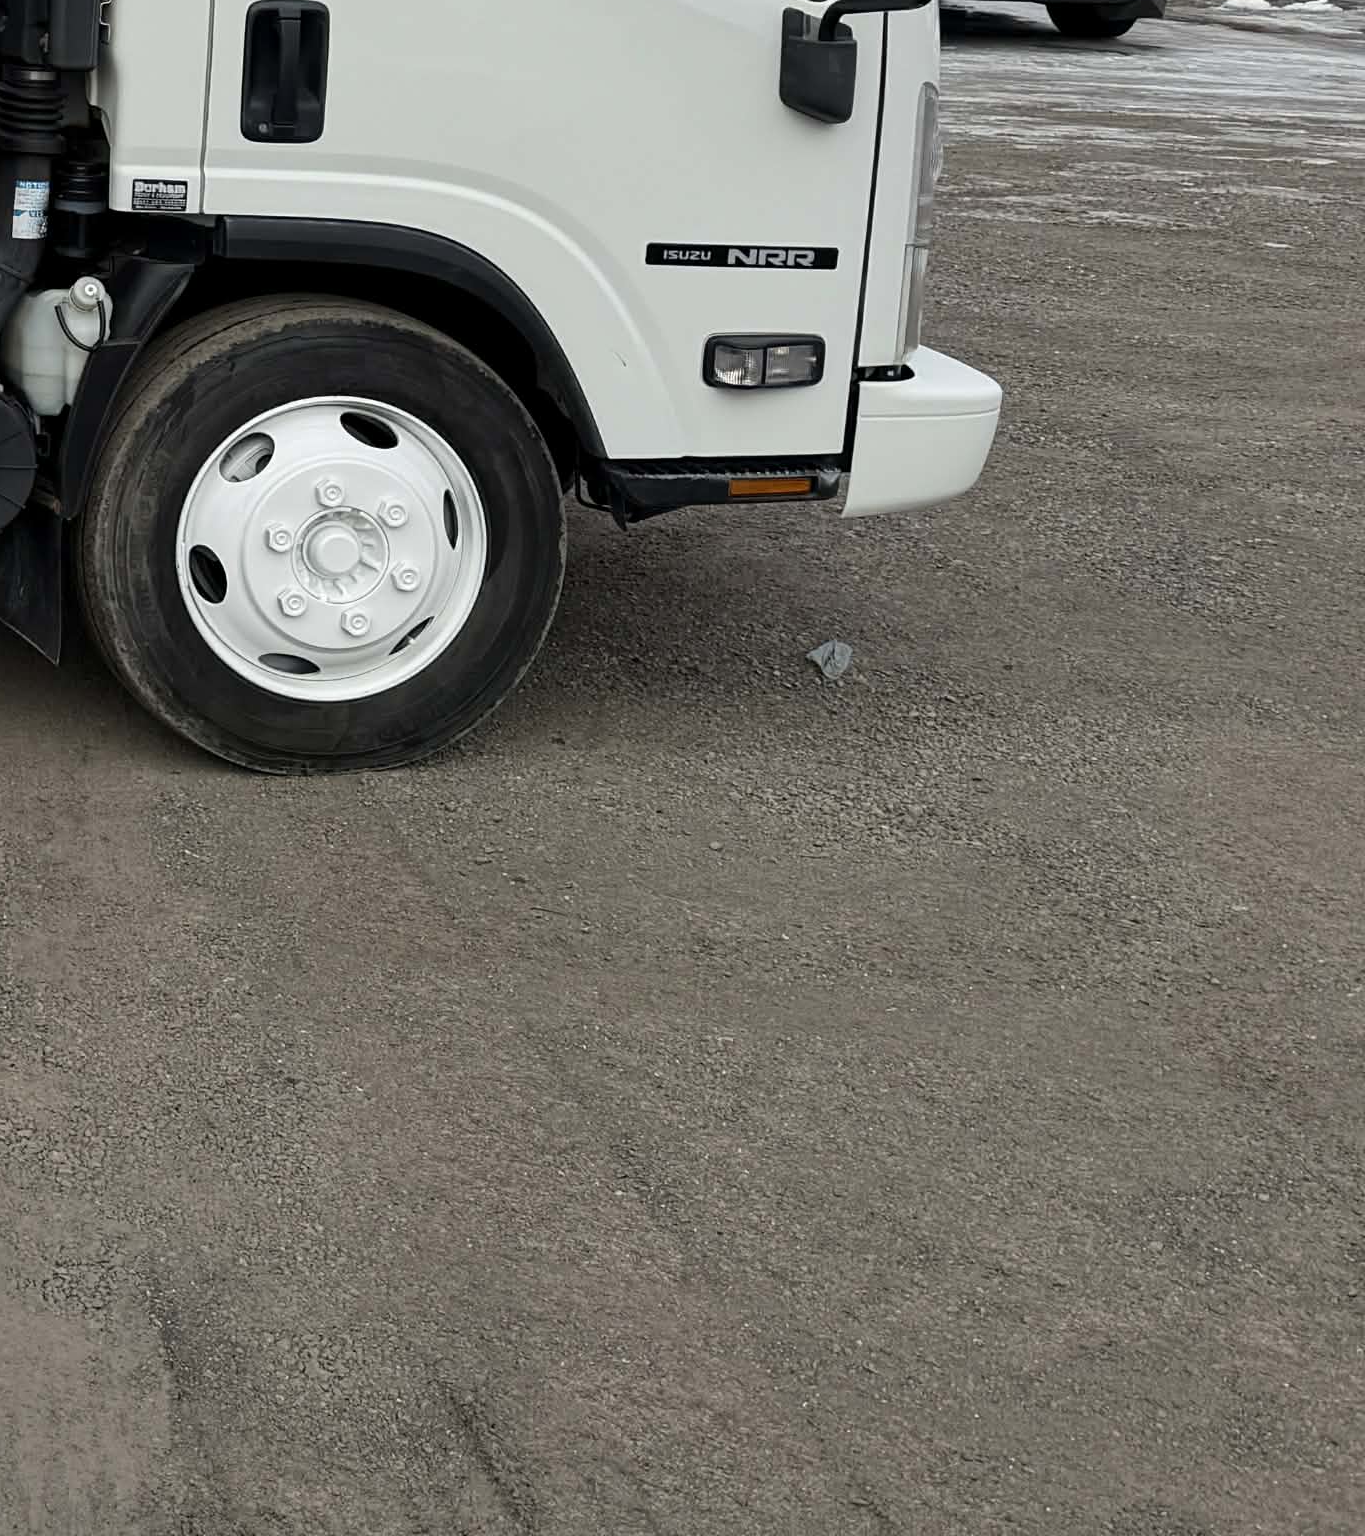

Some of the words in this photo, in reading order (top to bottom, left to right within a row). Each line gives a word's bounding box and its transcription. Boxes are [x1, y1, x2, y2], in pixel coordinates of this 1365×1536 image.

[134, 181, 186, 194] Durham
[663, 249, 712, 261] ISUZU
[727, 248, 815, 267] NRR
